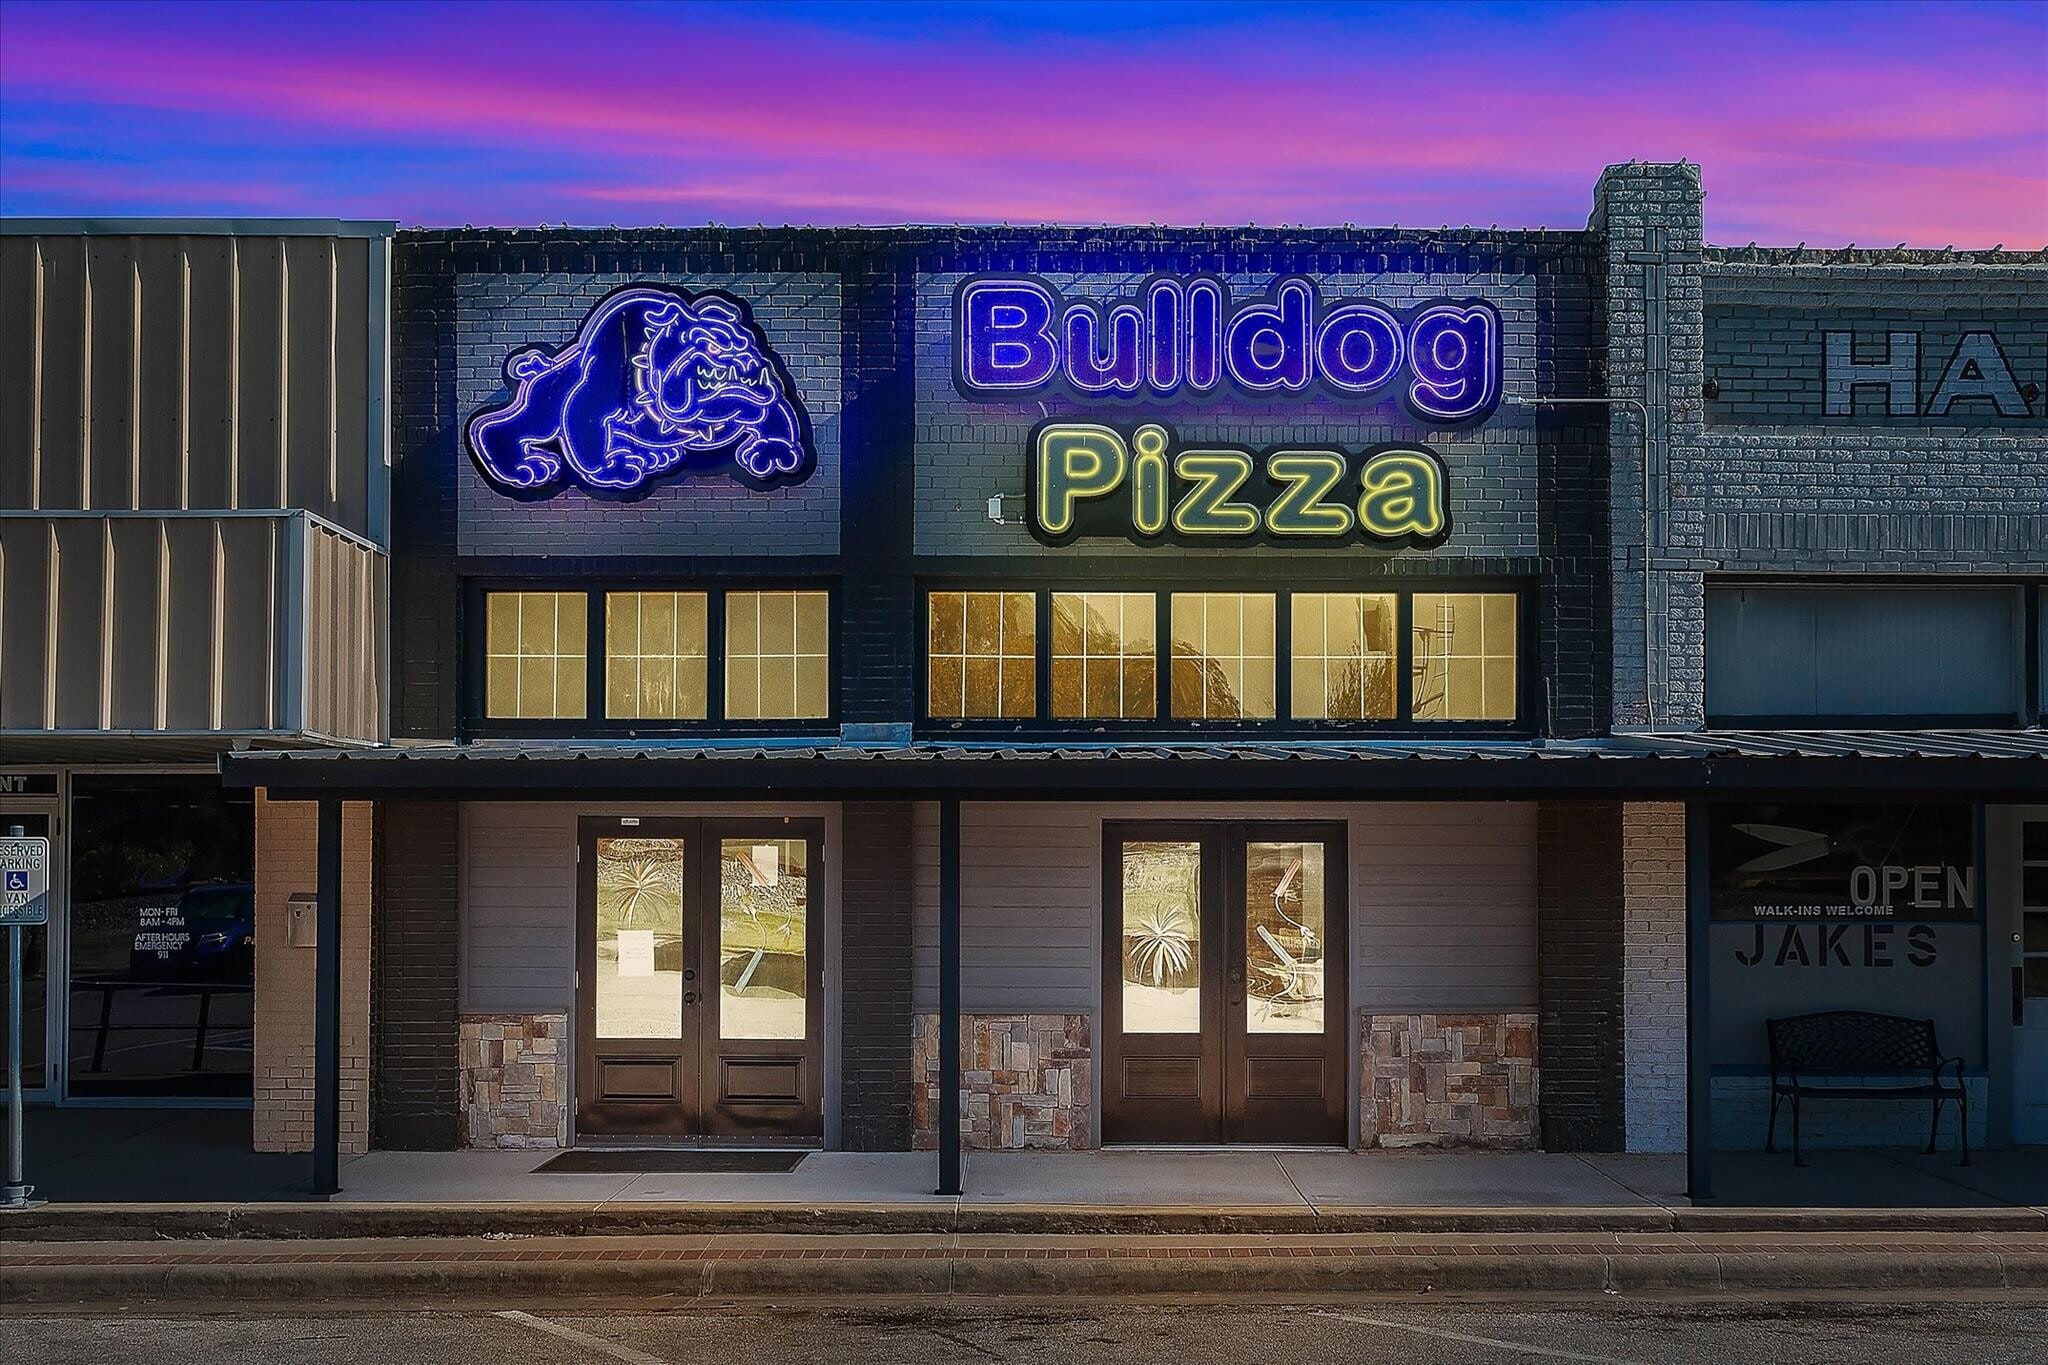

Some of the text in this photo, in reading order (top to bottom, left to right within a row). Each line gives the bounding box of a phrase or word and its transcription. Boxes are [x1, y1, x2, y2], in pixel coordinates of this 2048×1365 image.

[962, 278, 1497, 418] Bulldog
[1036, 423, 1446, 538] Pizza
[1850, 864, 1976, 909] OPEN
[6, 893, 28, 904] VAN
[1753, 905, 1894, 916] WALK-INS WELCOME
[135, 933, 190, 941] AFTER HOURS
[134, 942, 183, 950] EMERGENCY
[1735, 924, 1937, 967] JAKES
[158, 951, 169, 959] 911
